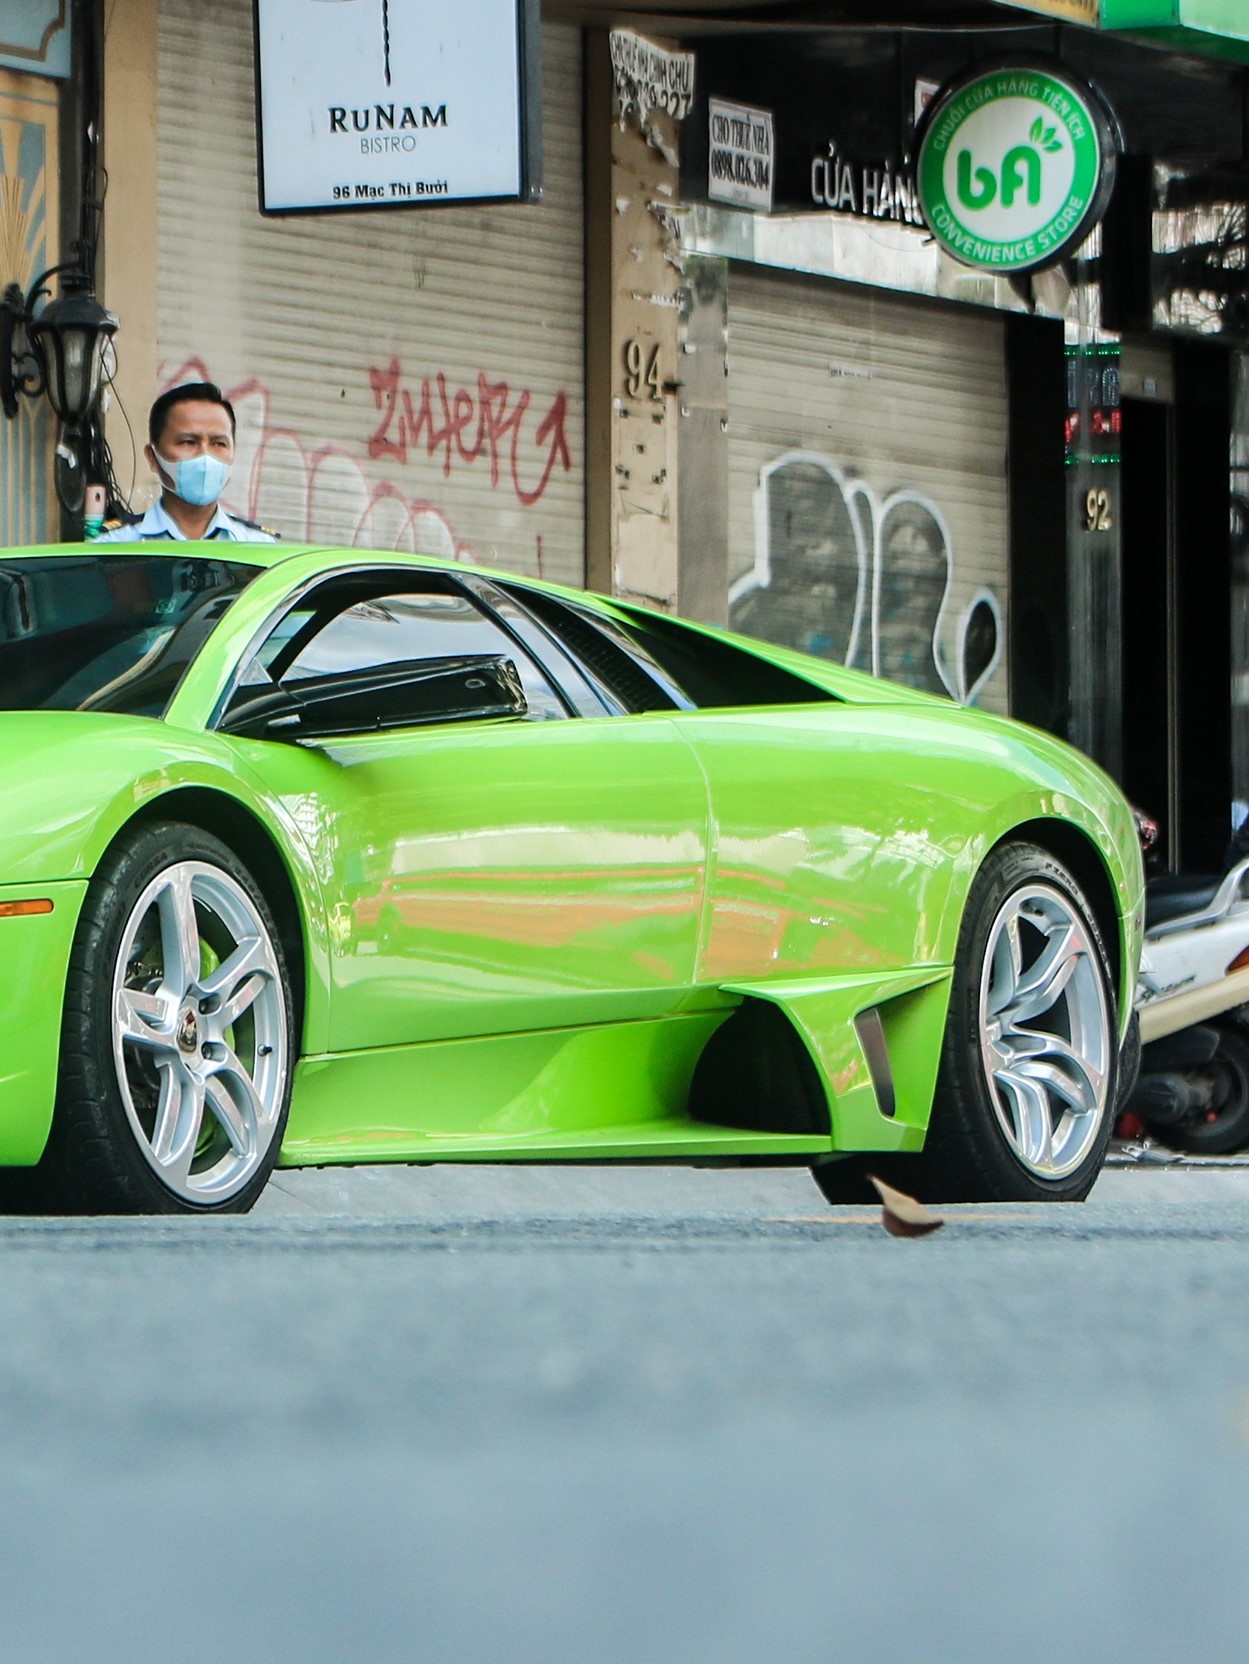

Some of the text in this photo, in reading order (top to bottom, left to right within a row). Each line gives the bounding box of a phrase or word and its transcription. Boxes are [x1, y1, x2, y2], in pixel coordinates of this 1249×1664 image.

[711, 114, 729, 145] CHO
[752, 118, 770, 156] NHÀ
[997, 77, 1038, 96] HÀNG
[1065, 111, 1086, 141] ÍCH
[360, 135, 416, 154] BISTRO
[332, 179, 448, 200] 96 Mạc Thị Bưởi
[811, 139, 856, 212] CỬA
[931, 195, 1083, 263] CONVENIENCE STORE
[626, 339, 664, 400] 94
[1087, 489, 1112, 532] 92
